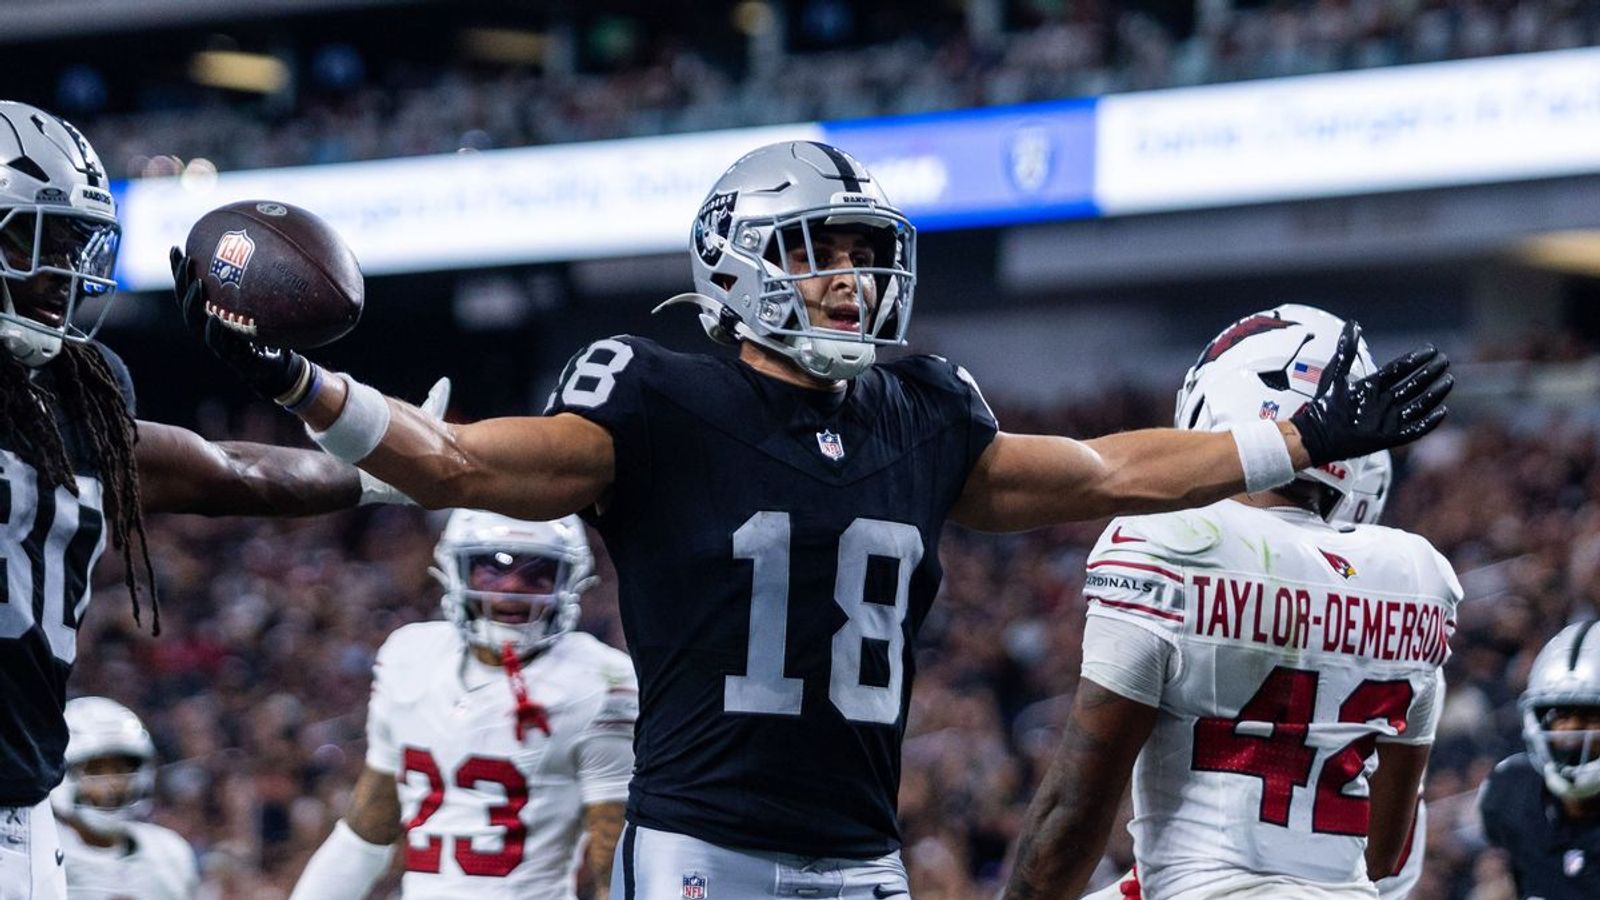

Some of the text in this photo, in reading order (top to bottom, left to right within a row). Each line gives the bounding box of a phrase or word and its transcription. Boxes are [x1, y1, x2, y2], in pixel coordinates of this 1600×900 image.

[220, 236, 249, 266] NFL
[543, 338, 634, 415] 8
[724, 511, 924, 724] 18
[399, 746, 530, 878] 23
[1190, 666, 1414, 838] 42
